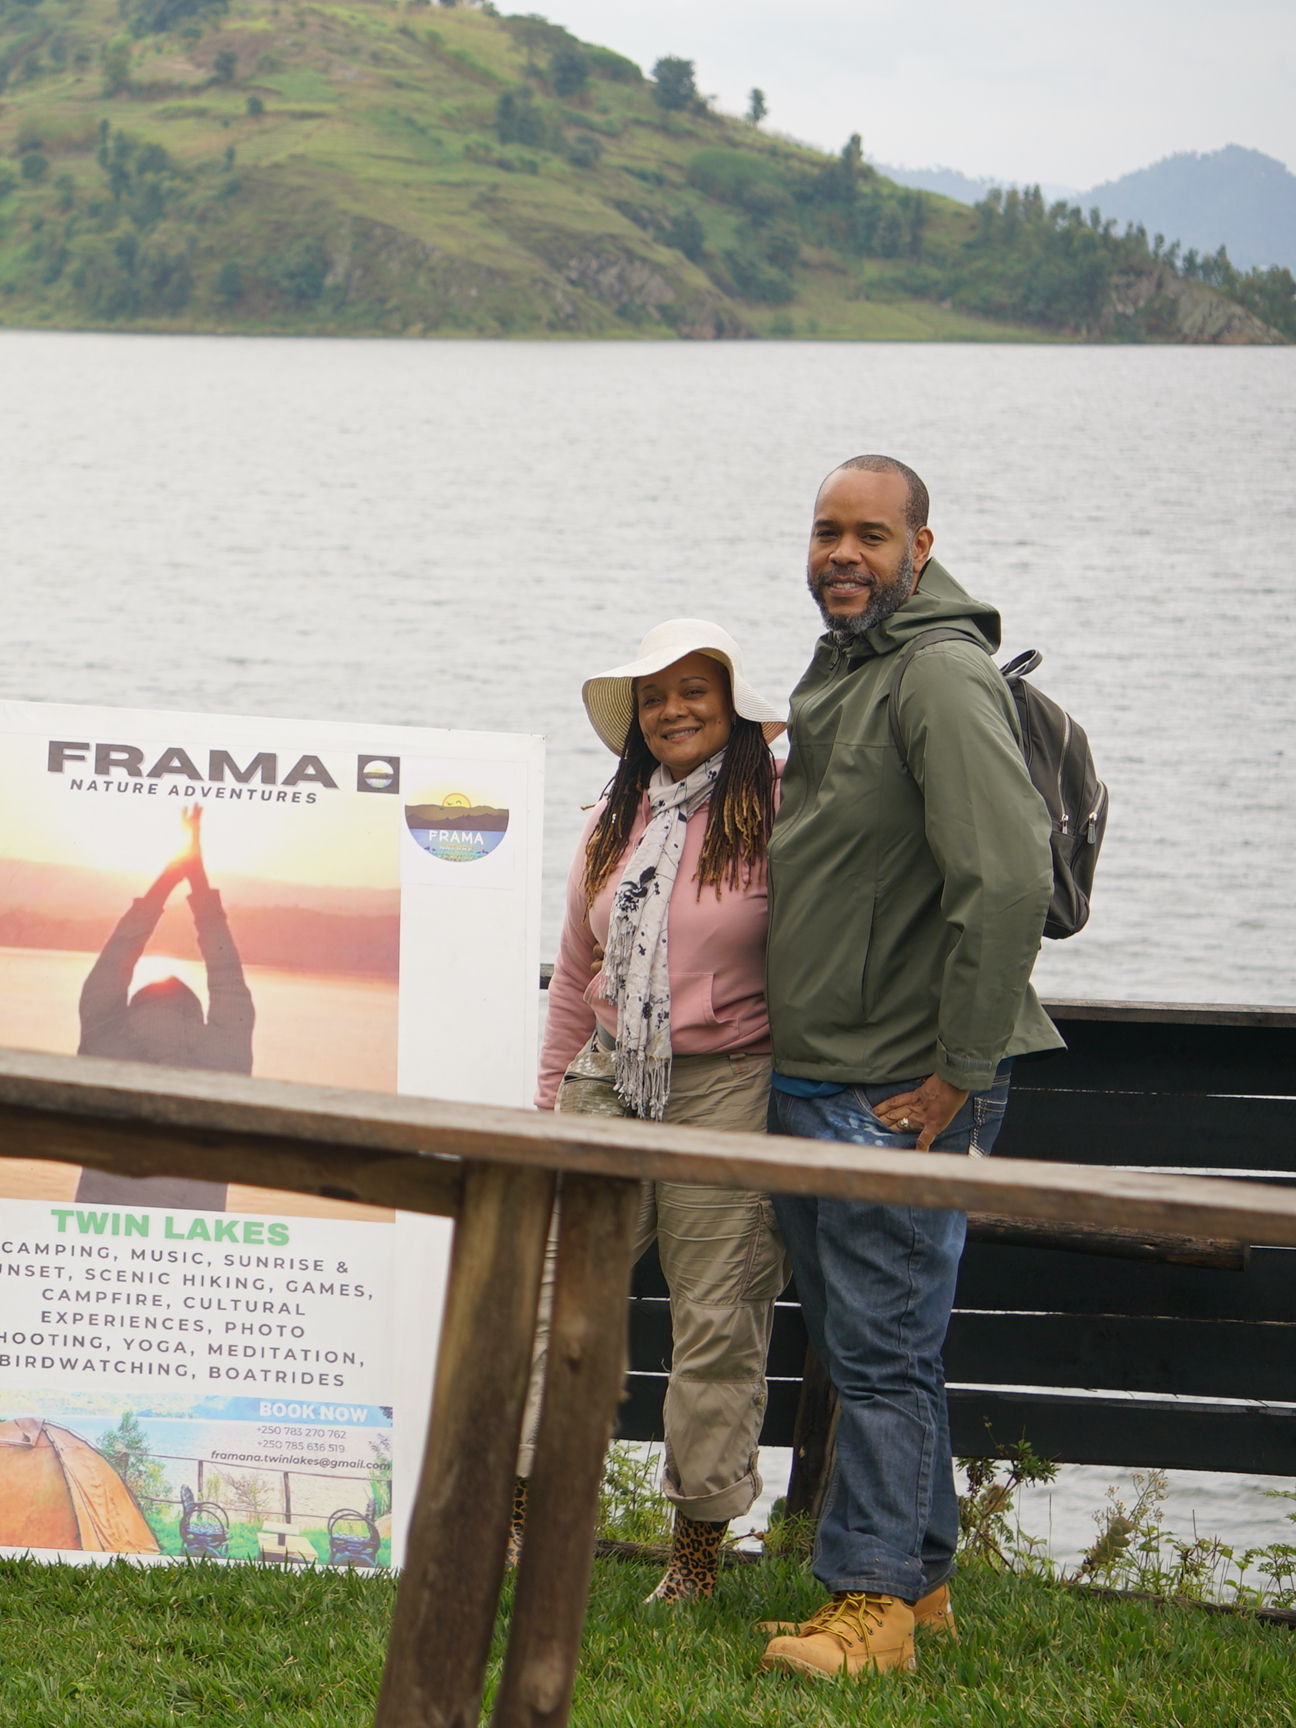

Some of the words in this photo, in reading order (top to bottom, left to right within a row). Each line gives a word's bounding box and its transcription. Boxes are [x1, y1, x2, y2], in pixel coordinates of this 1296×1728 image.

[47, 740, 339, 789] FRAMA
[70, 779, 158, 795] NATURE
[168, 784, 318, 804] ADVENTURES
[429, 830, 484, 845] FRAMA
[51, 1209, 150, 1237] TWIN
[164, 1217, 289, 1246] LAKES
[2, 1241, 118, 1261] CAMPING,
[130, 1248, 212, 1267] MUSIC,
[224, 1254, 325, 1272] SUNRISE
[336, 1261, 349, 1274] &
[85, 1268, 171, 1285] SCENIC
[183, 1273, 274, 1293] HIKING,
[286, 1280, 374, 1300] GAMES,
[42, 1288, 171, 1310] CAMPFIRE,
[183, 1296, 305, 1315] CULTURAL
[41, 1311, 212, 1334] EXPERIENCES,
[225, 1322, 305, 1338] PHOTO
[123, 1338, 195, 1356] YOGA,
[208, 1344, 365, 1367] MEDITATION,
[209, 1367, 345, 1386] BOATRIDES
[260, 1401, 315, 1419] BOOK
[320, 1406, 368, 1422] NOW
[257, 1425, 282, 1435] +250
[284, 1426, 303, 1437] 783
[305, 1427, 325, 1438] 270
[328, 1429, 347, 1440] 762
[258, 1439, 283, 1450] +250
[285, 1440, 305, 1451] 785
[307, 1442, 326, 1452] 636
[328, 1443, 346, 1454] 519
[211, 1451, 391, 1470] framana.twinlakes@gmail.com
